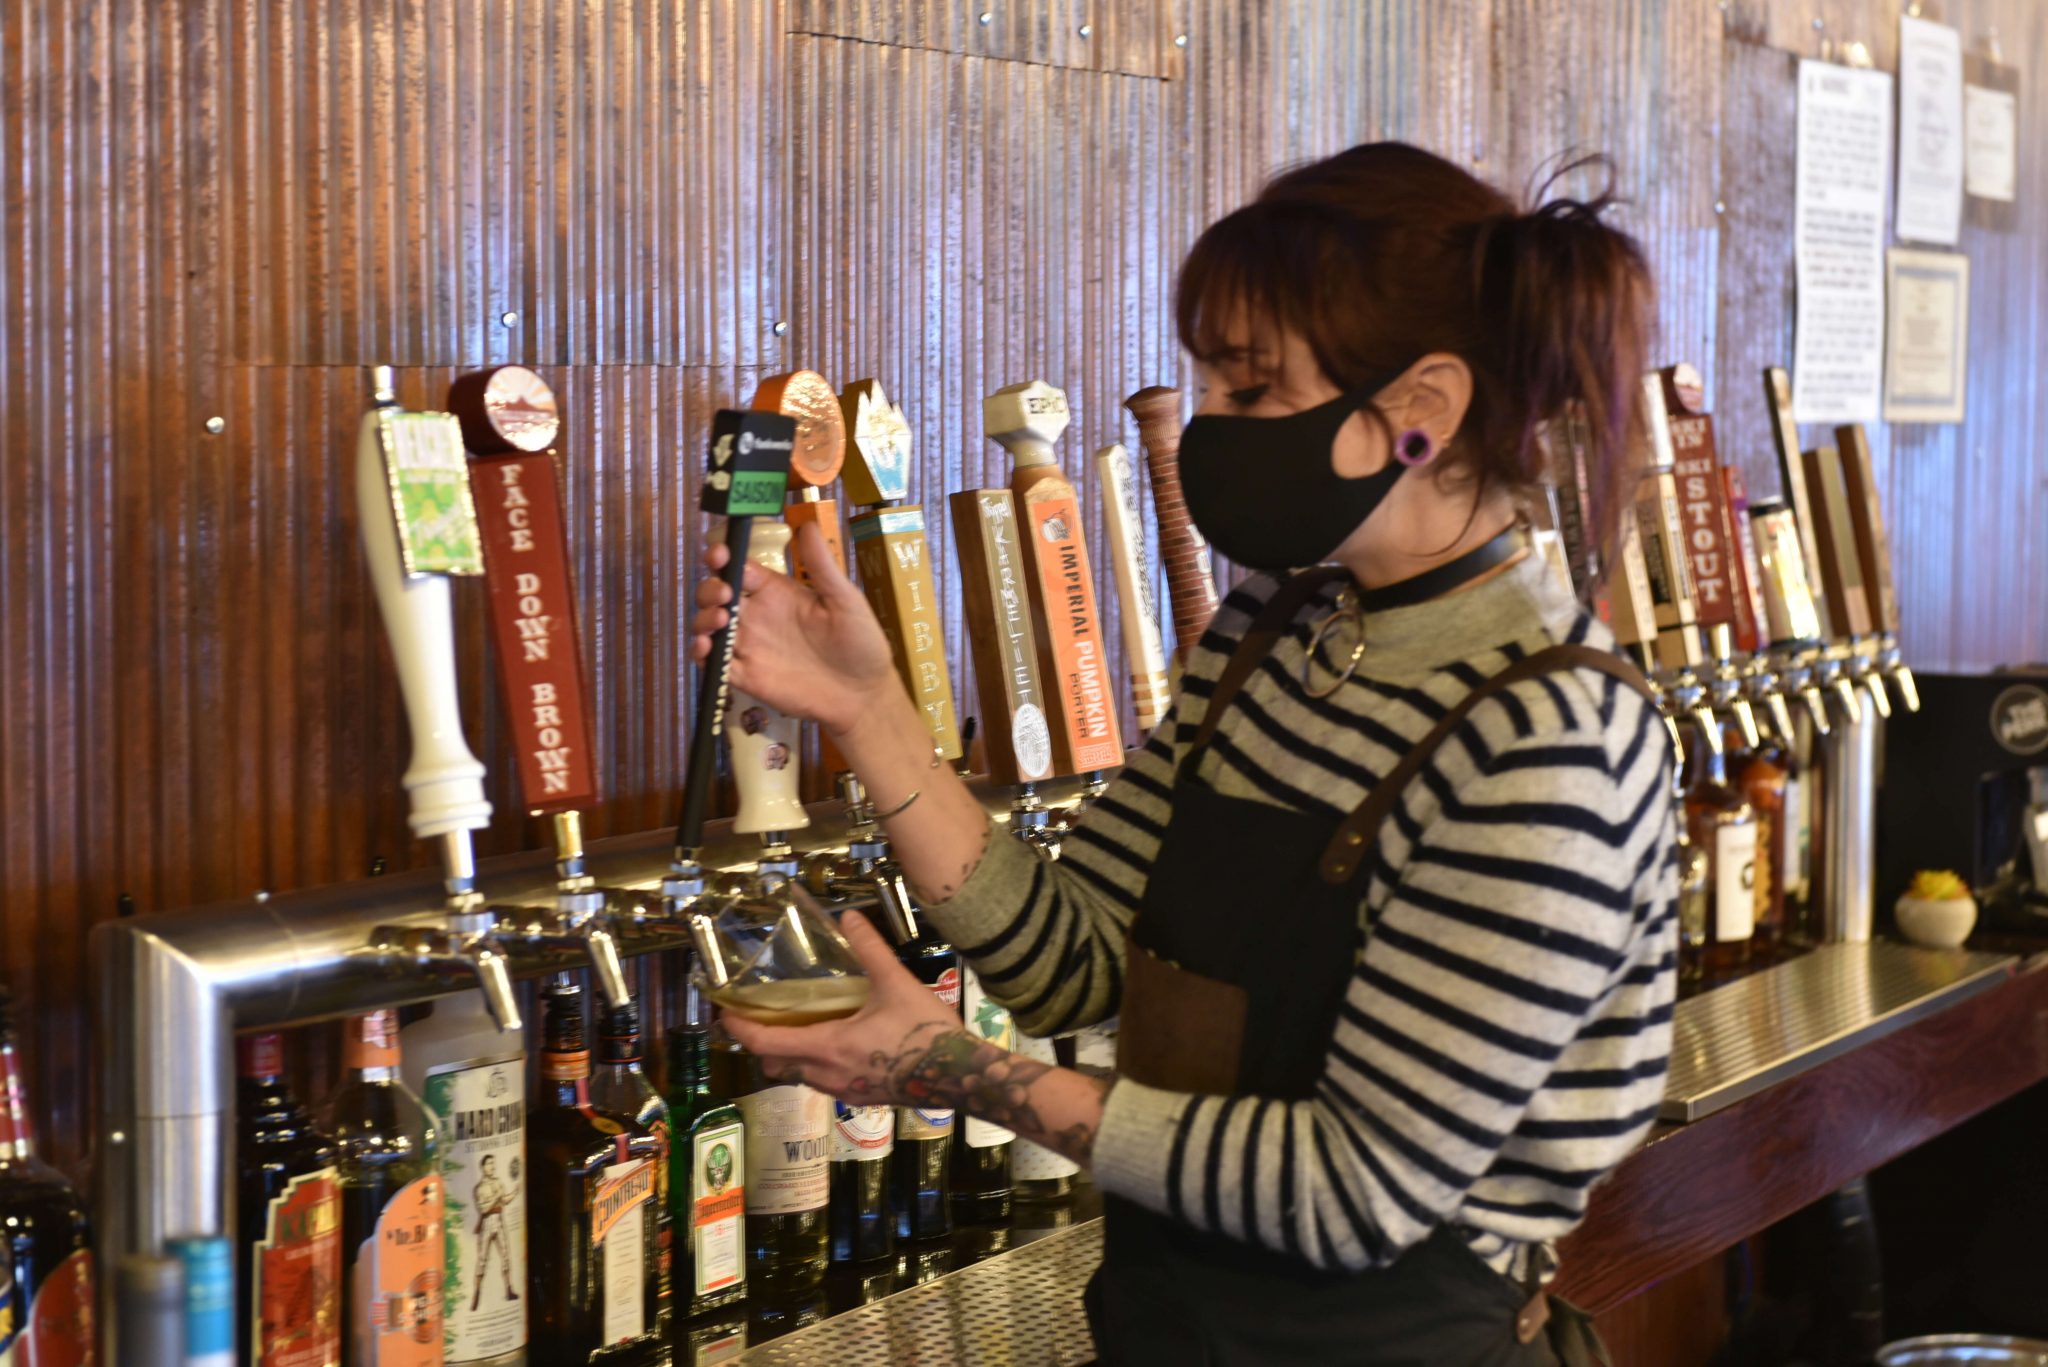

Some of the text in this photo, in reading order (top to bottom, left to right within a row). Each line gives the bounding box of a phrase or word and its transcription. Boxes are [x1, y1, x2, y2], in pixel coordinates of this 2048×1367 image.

[1028, 397, 1065, 414] EPIC
[1677, 433, 1703, 449] IN
[500, 463, 535, 552] FACE
[731, 481, 786, 504] SAISON
[1685, 476, 1723, 603] STOUT
[514, 573, 553, 663] DOWN
[891, 538, 947, 732] WIBBY
[1059, 545, 1090, 637] IMPERIAL
[1069, 672, 1091, 740] PORTER
[1074, 639, 1109, 739] PUMPKIN
[531, 682, 573, 795] BROWN
